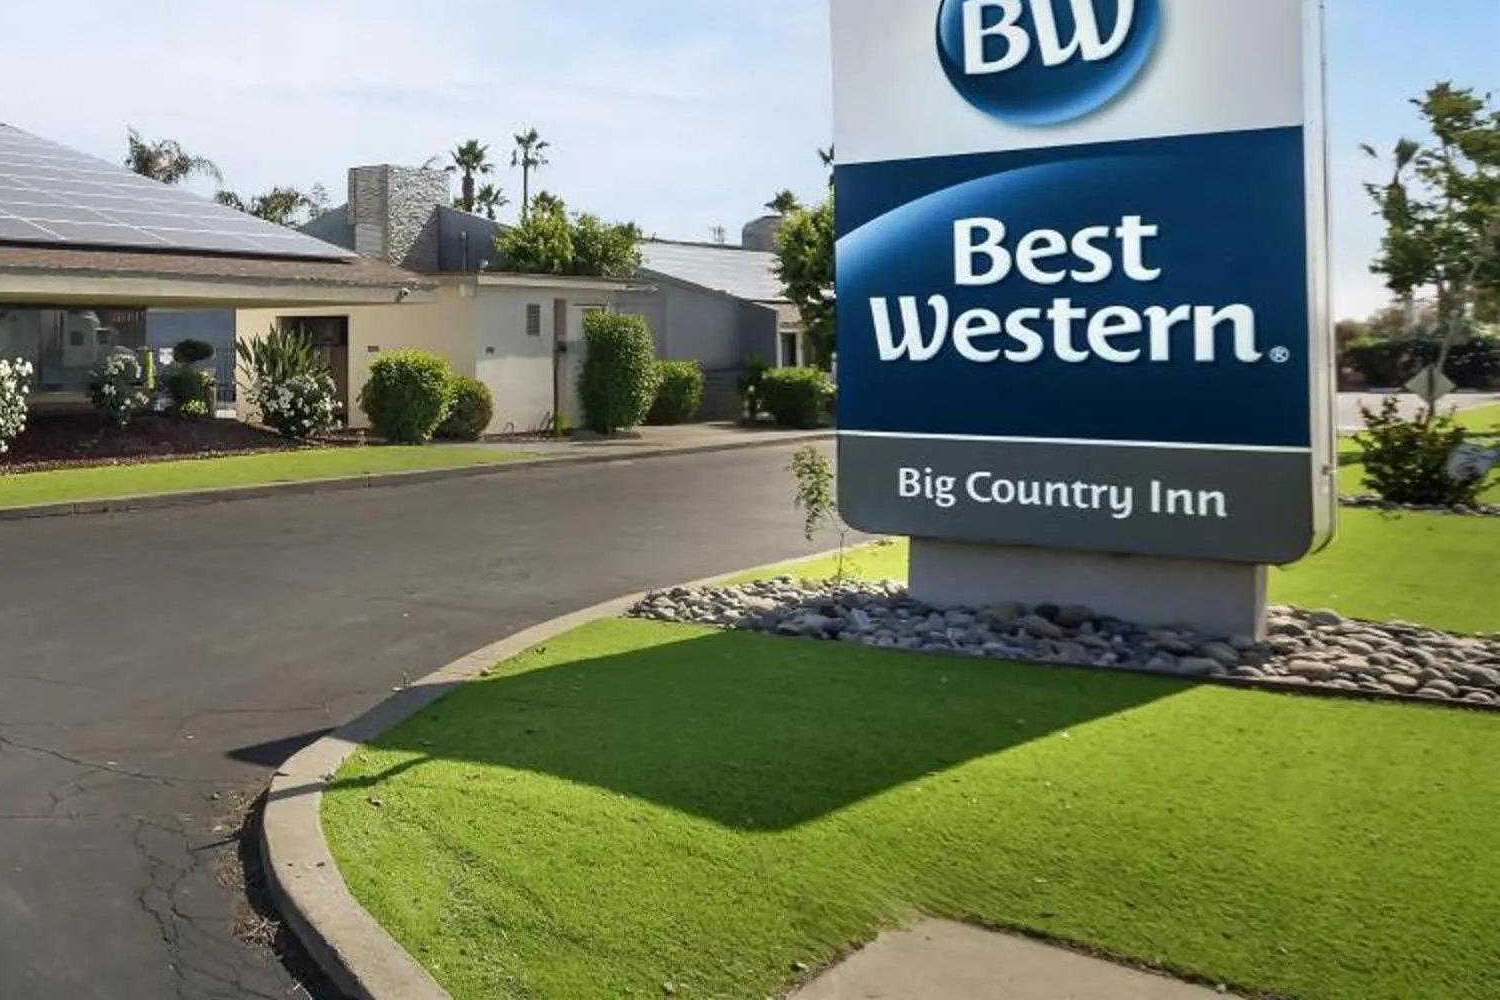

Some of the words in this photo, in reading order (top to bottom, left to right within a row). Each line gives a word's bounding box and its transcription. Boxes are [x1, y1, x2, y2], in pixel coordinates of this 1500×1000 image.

[953, 215, 1161, 285] Best
[898, 466, 956, 507] Big
[965, 470, 1134, 519] Country
[1150, 480, 1227, 517] Inn
